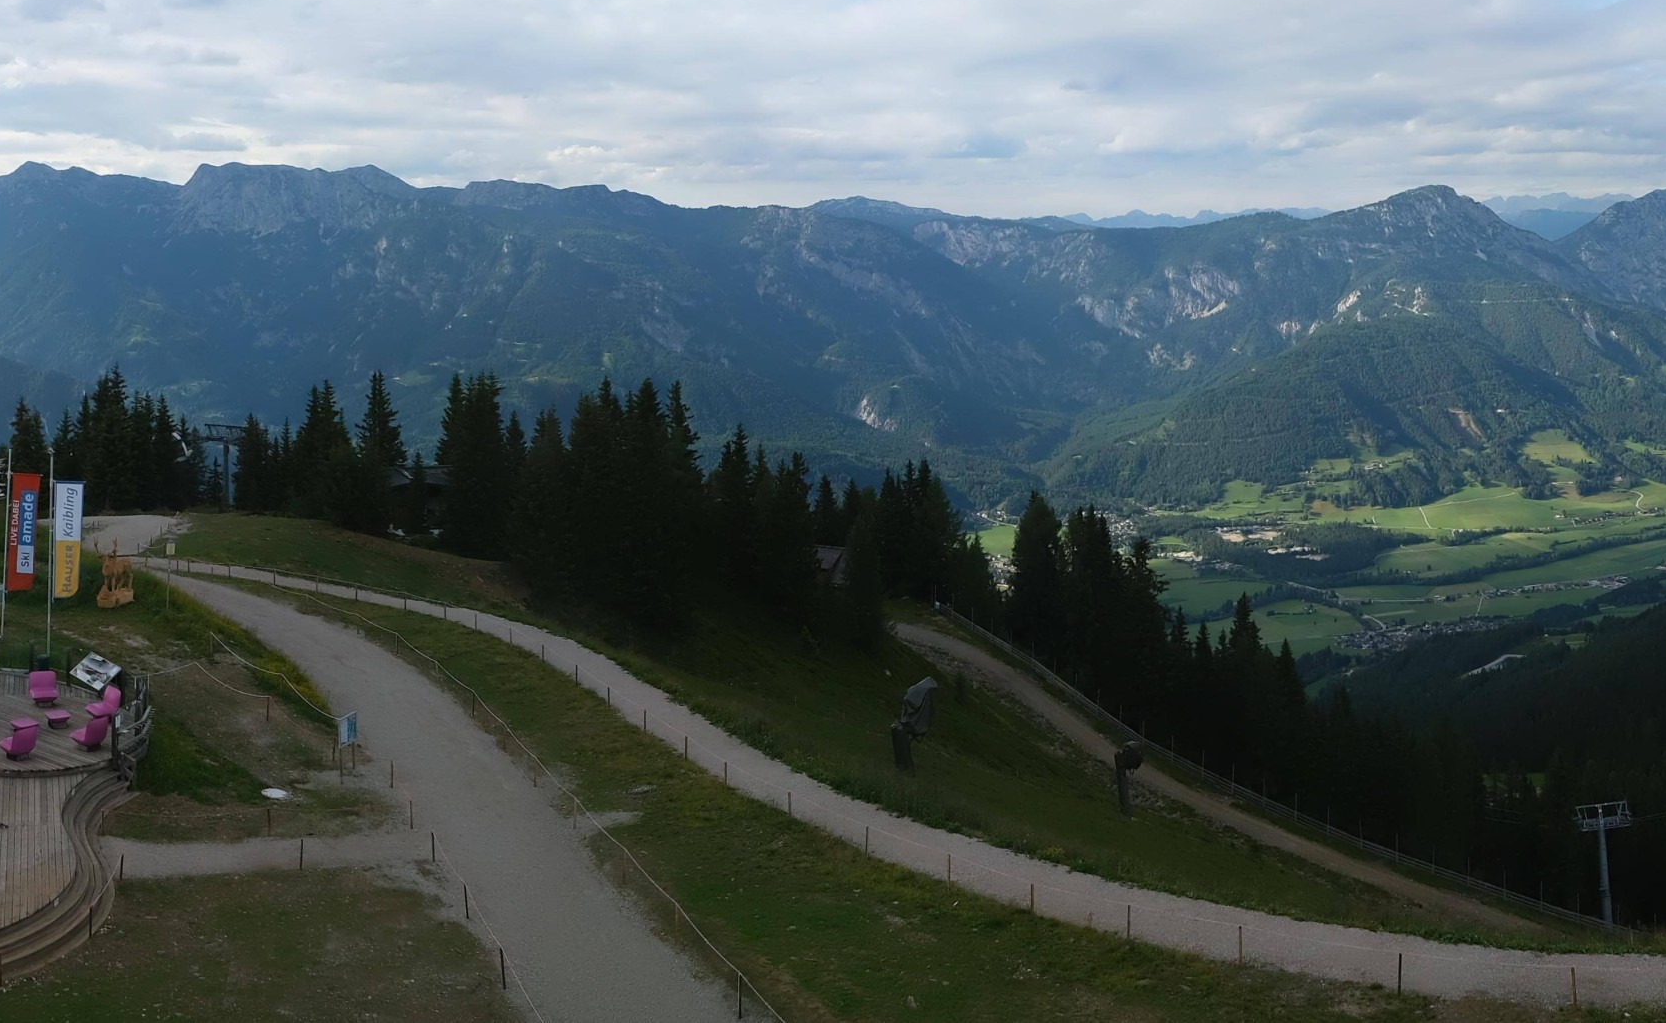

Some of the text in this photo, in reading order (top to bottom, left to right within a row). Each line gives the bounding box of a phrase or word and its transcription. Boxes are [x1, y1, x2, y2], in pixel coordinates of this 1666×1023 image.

[10, 499, 20, 546] LIVE DABEI
[62, 487, 78, 593] HAUSER Kaibling
